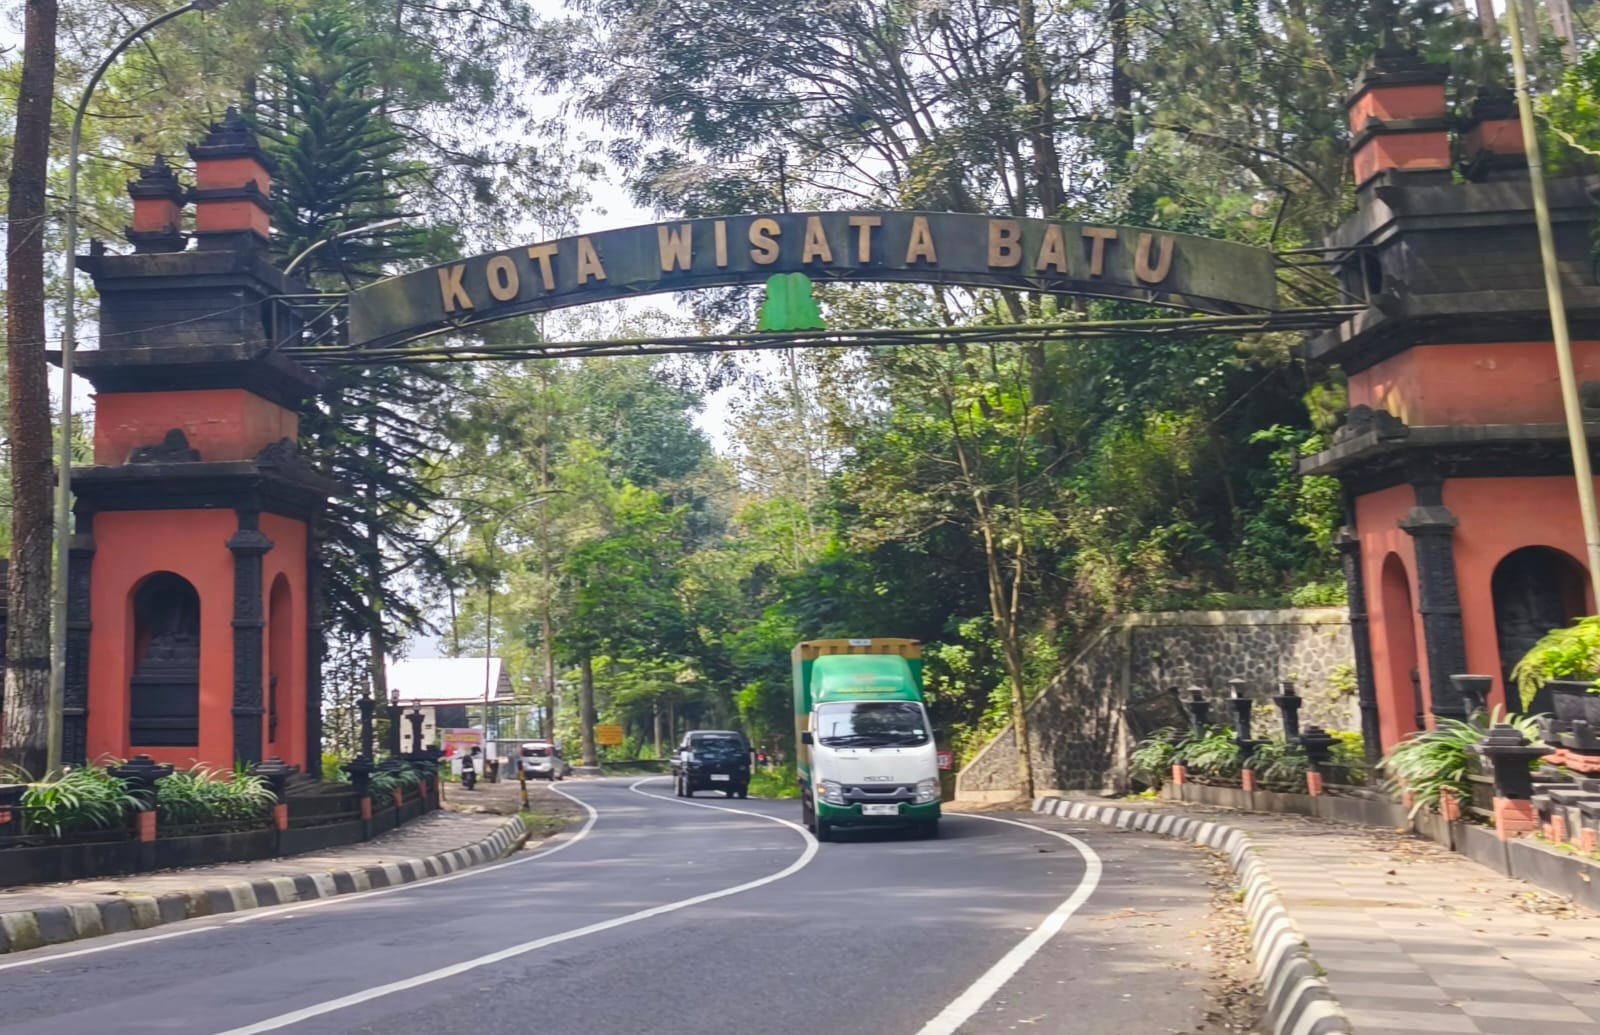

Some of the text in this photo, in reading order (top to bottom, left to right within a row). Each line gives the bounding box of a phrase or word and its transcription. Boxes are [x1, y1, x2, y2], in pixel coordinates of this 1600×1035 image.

[437, 215, 1175, 313] KOTA WISATA BATU
